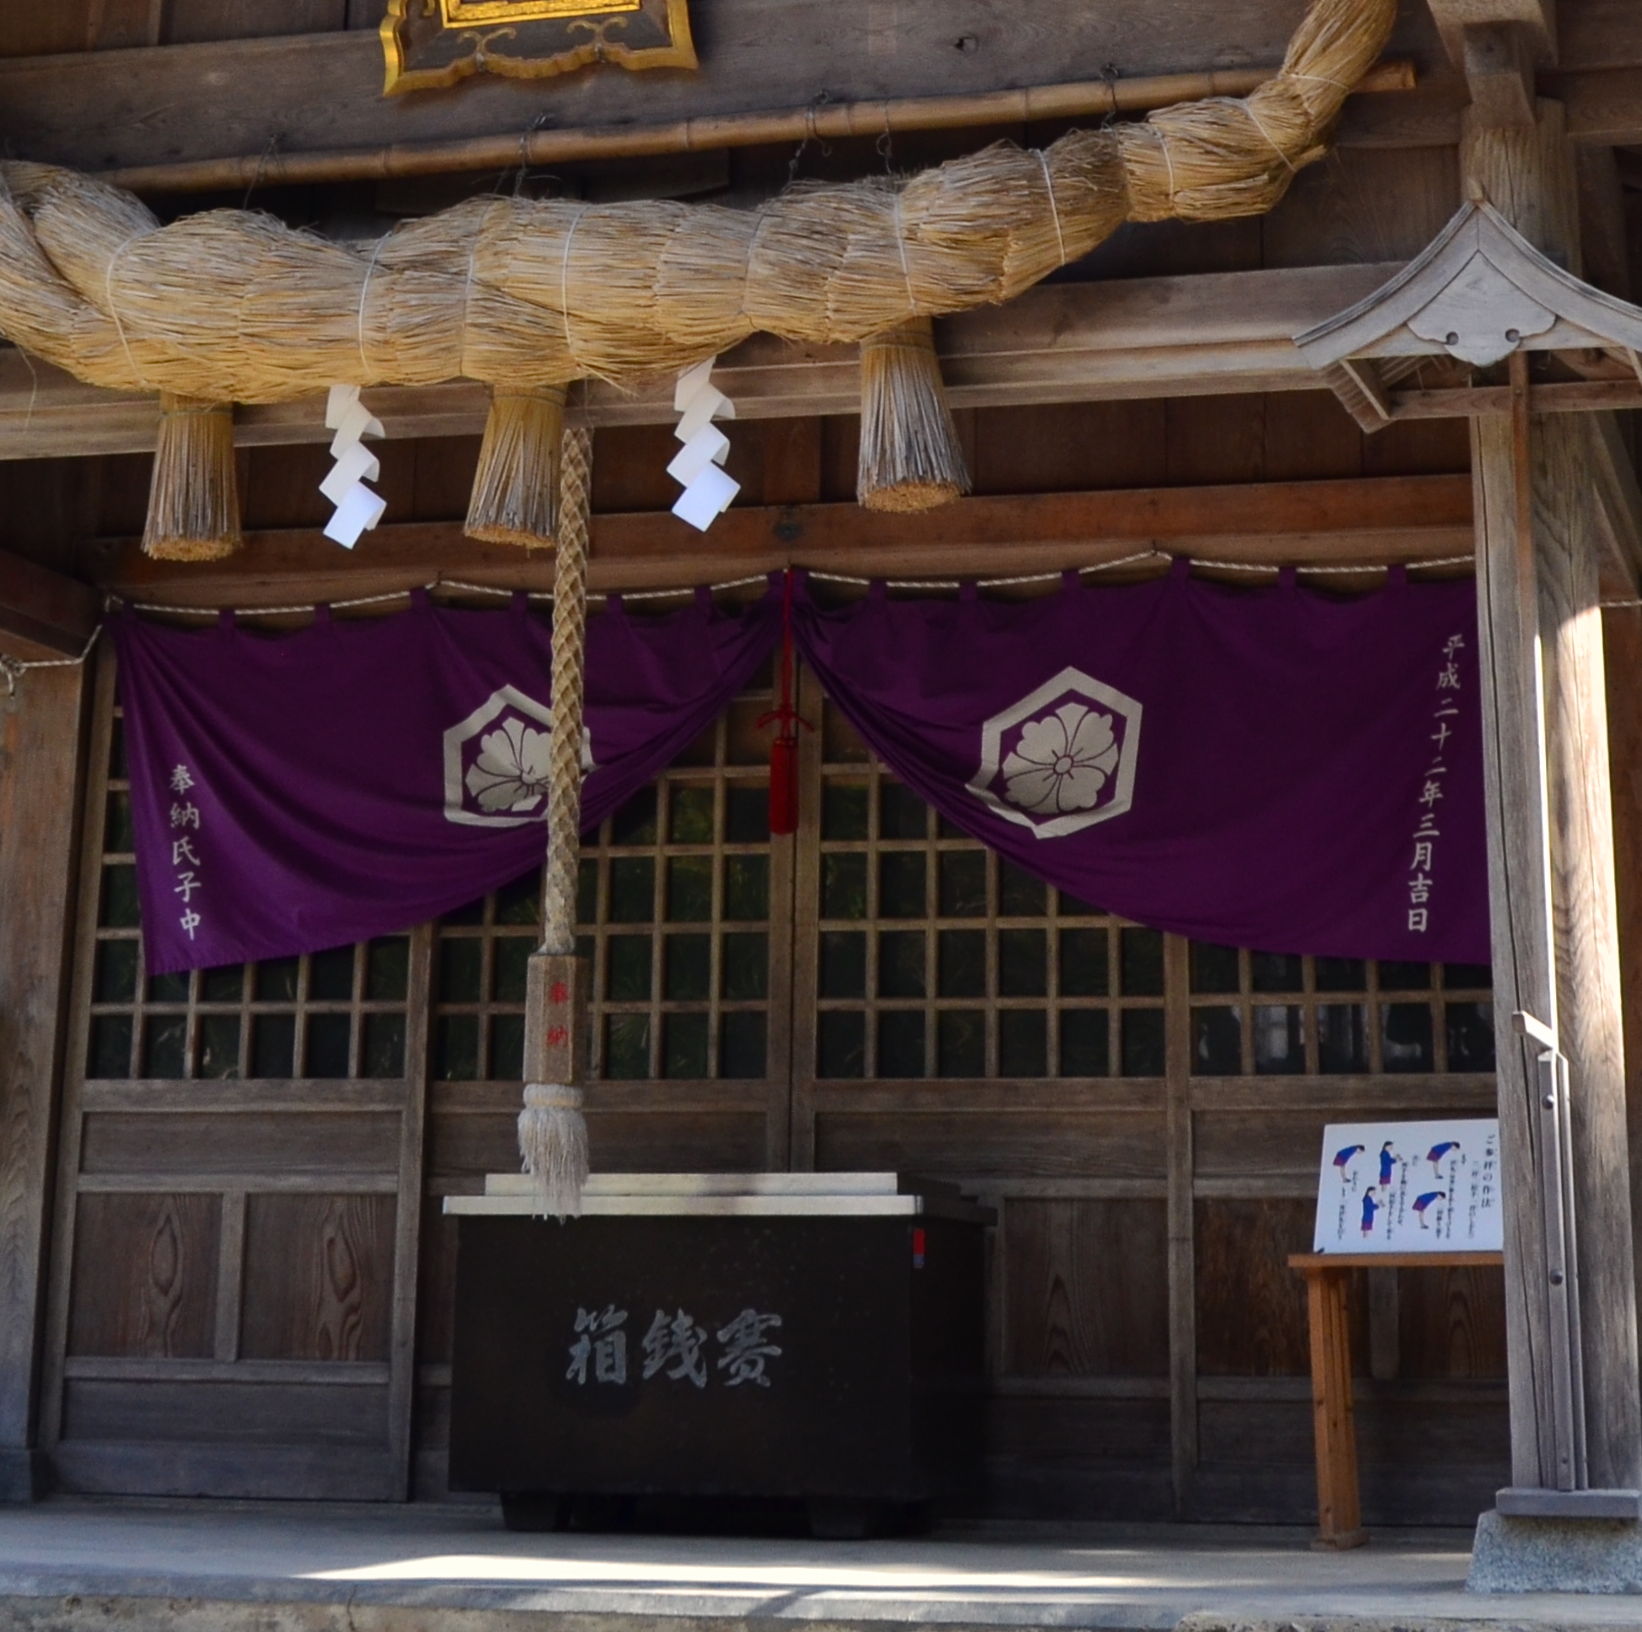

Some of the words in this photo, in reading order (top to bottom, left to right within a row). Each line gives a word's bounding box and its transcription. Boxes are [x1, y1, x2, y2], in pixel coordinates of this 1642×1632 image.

[168, 764, 202, 942] 奉納氏子中
[1407, 633, 1466, 933] 平成二十二年三月吉日
